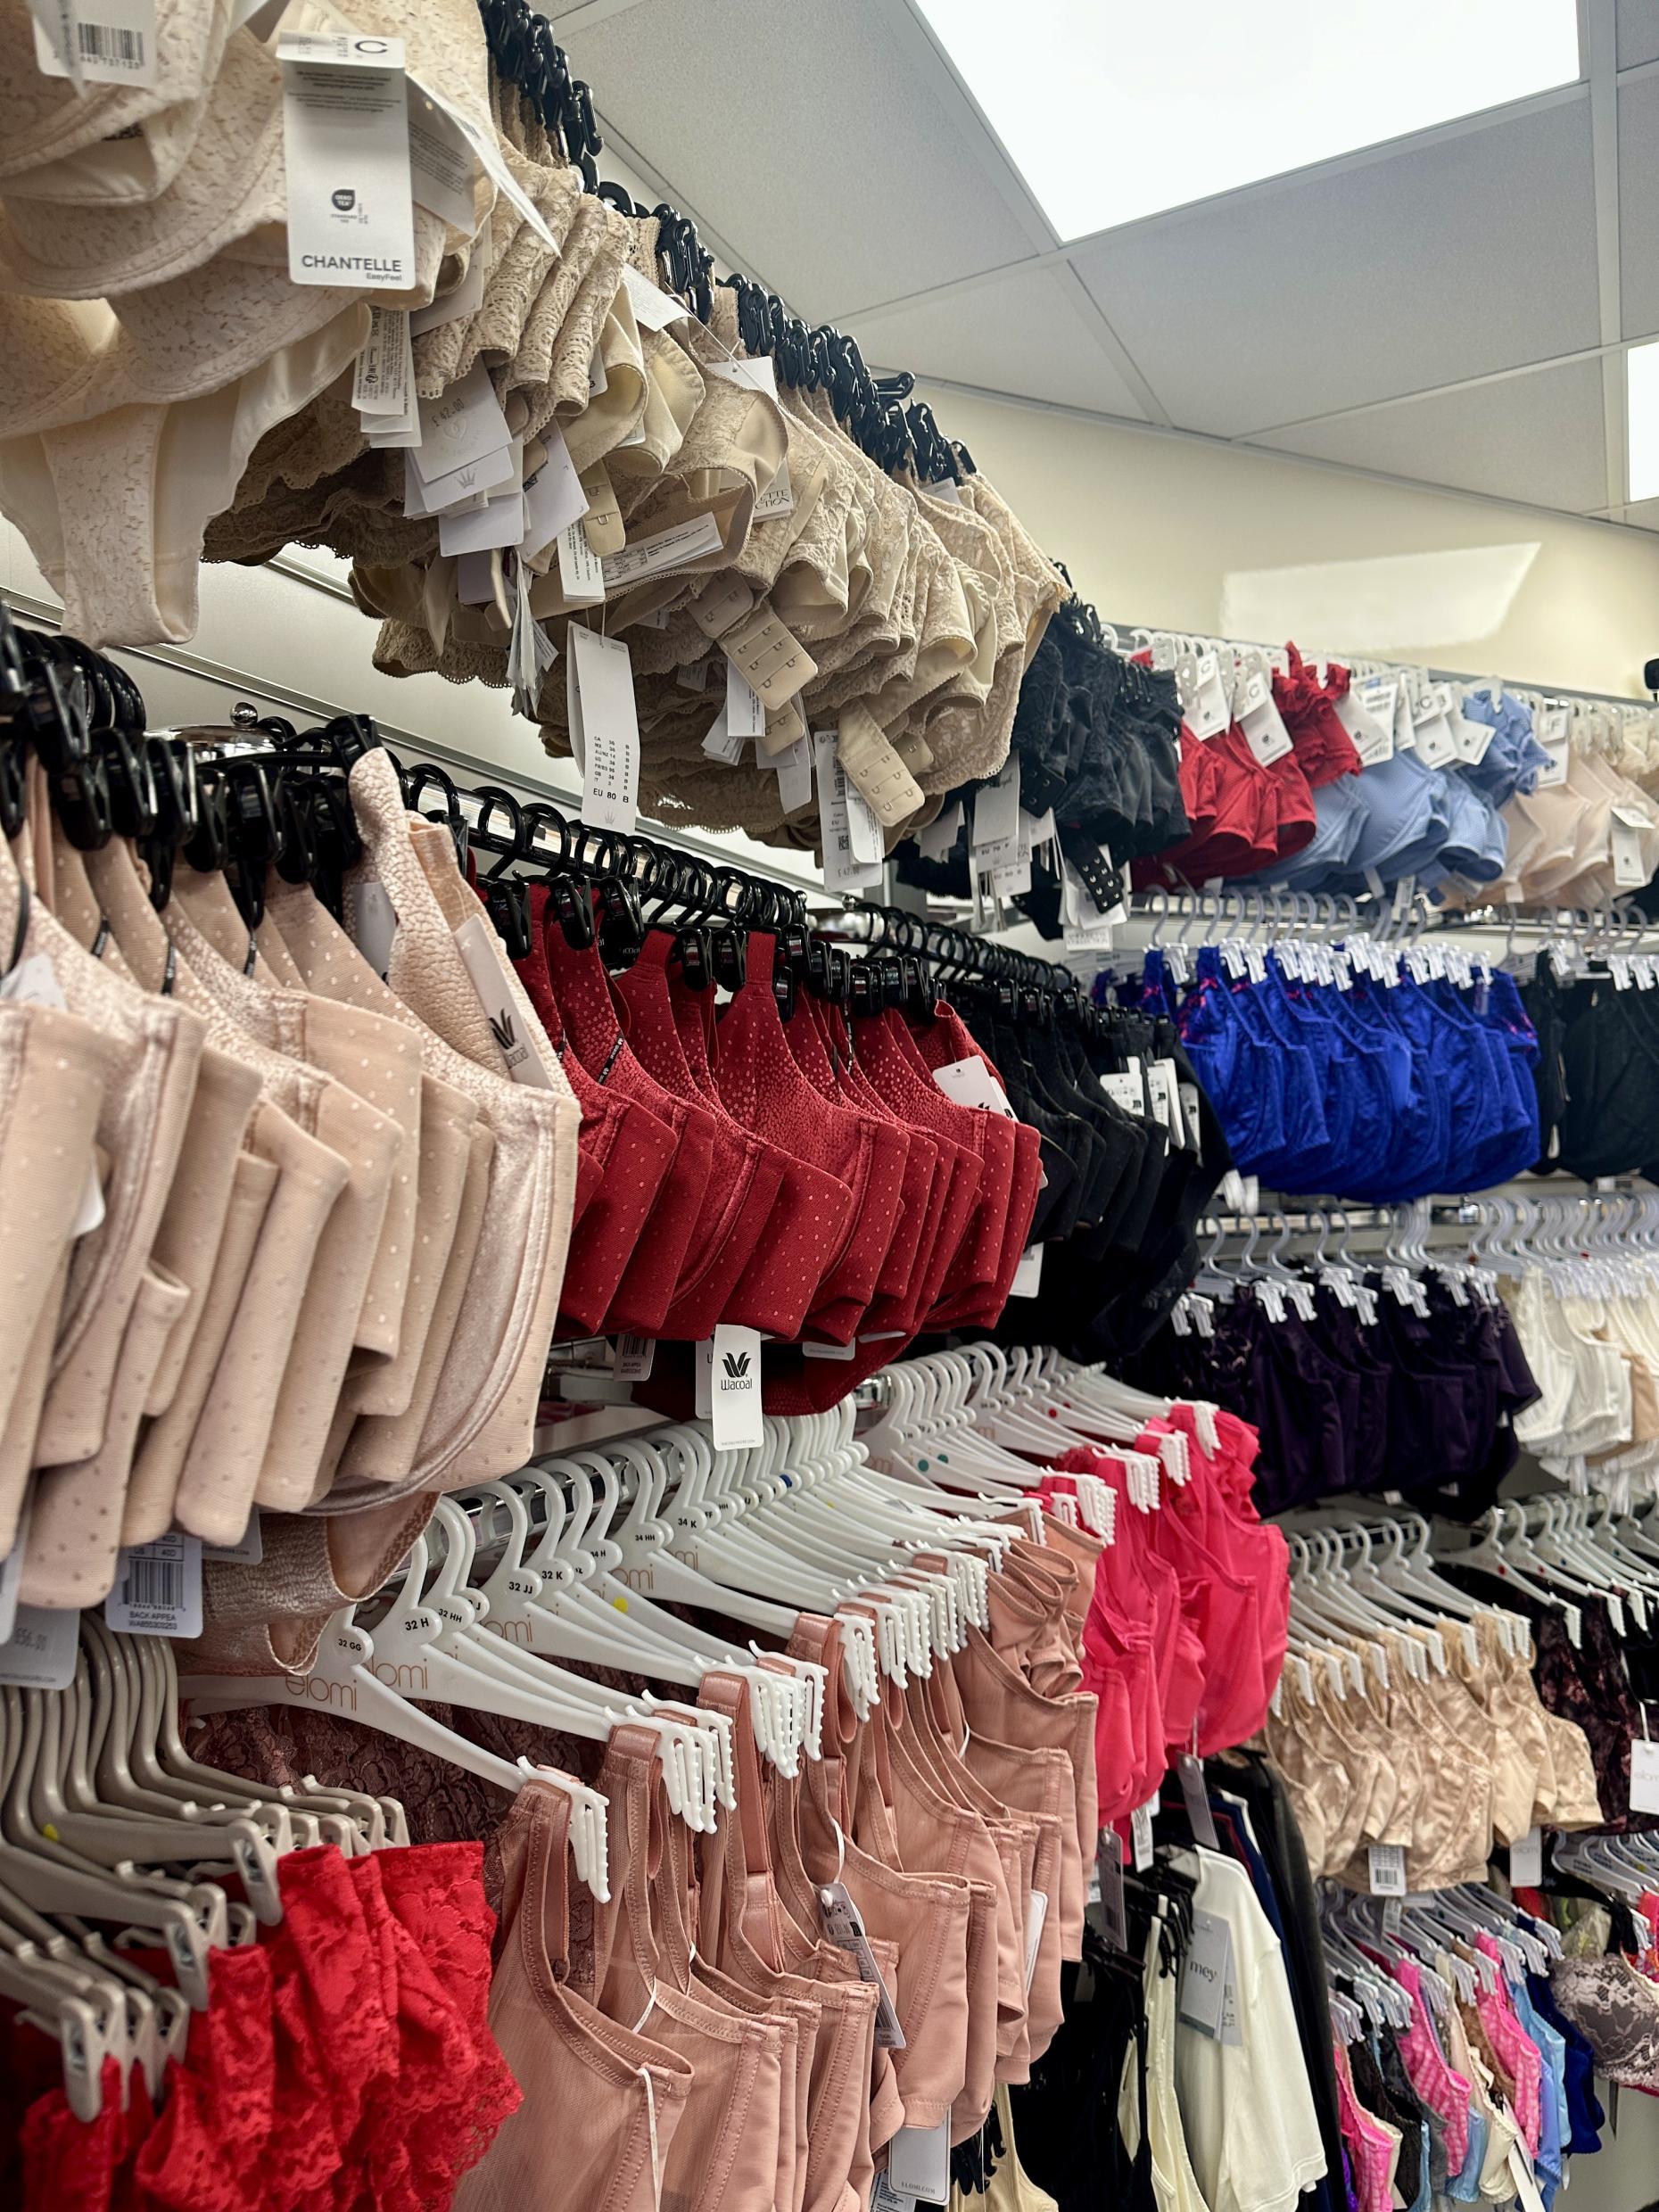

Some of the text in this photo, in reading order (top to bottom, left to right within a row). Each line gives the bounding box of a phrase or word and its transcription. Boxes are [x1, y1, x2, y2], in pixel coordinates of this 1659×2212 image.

[301, 255, 401, 272] CHANTELLE
[367, 273, 402, 282] EasyFeel
[593, 788, 603, 796] EU
[607, 792, 616, 800] 80
[502, 1044, 529, 1069] acoal
[721, 1378, 753, 1391] Wacoal
[678, 1518, 697, 1529] 34 K
[541, 1571, 563, 1581] 32 K
[611, 1563, 654, 1589] omi
[508, 1581, 533, 1595] 32 JJ
[475, 1602, 481, 1611] J
[438, 1608, 462, 1623] 32 HH
[405, 1617, 429, 1631] 32 H
[484, 1614, 533, 1643] omi
[338, 1638, 362, 1651] 32 GG
[363, 1655, 428, 1690] lomi
[285, 1675, 357, 1712] elomi
[1190, 1960, 1217, 1983] mey
